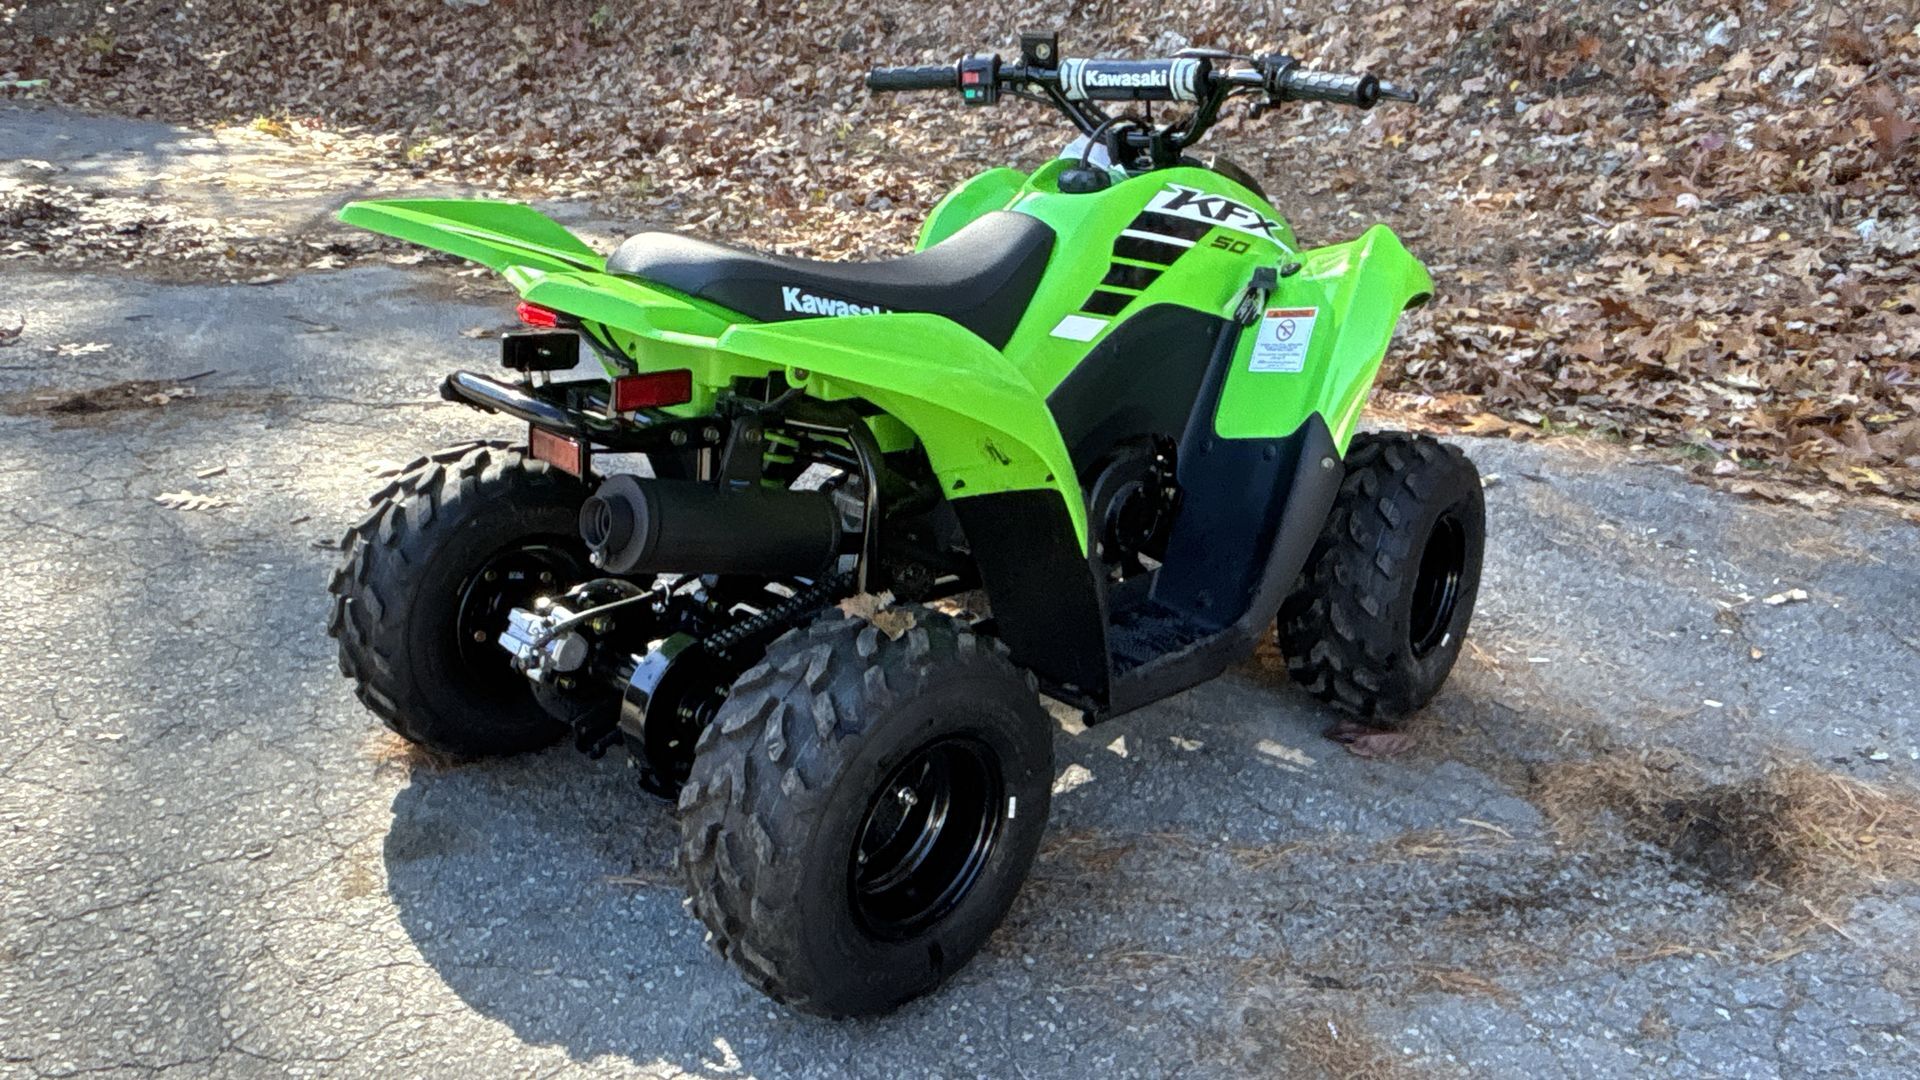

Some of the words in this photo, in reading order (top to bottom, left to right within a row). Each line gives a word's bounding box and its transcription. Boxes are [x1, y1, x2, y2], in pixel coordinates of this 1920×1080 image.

[1085, 69, 1167, 87] Kawasaki
[1161, 188, 1279, 240] KFX
[1210, 235, 1251, 255] 50
[781, 286, 893, 318] Kawasa
